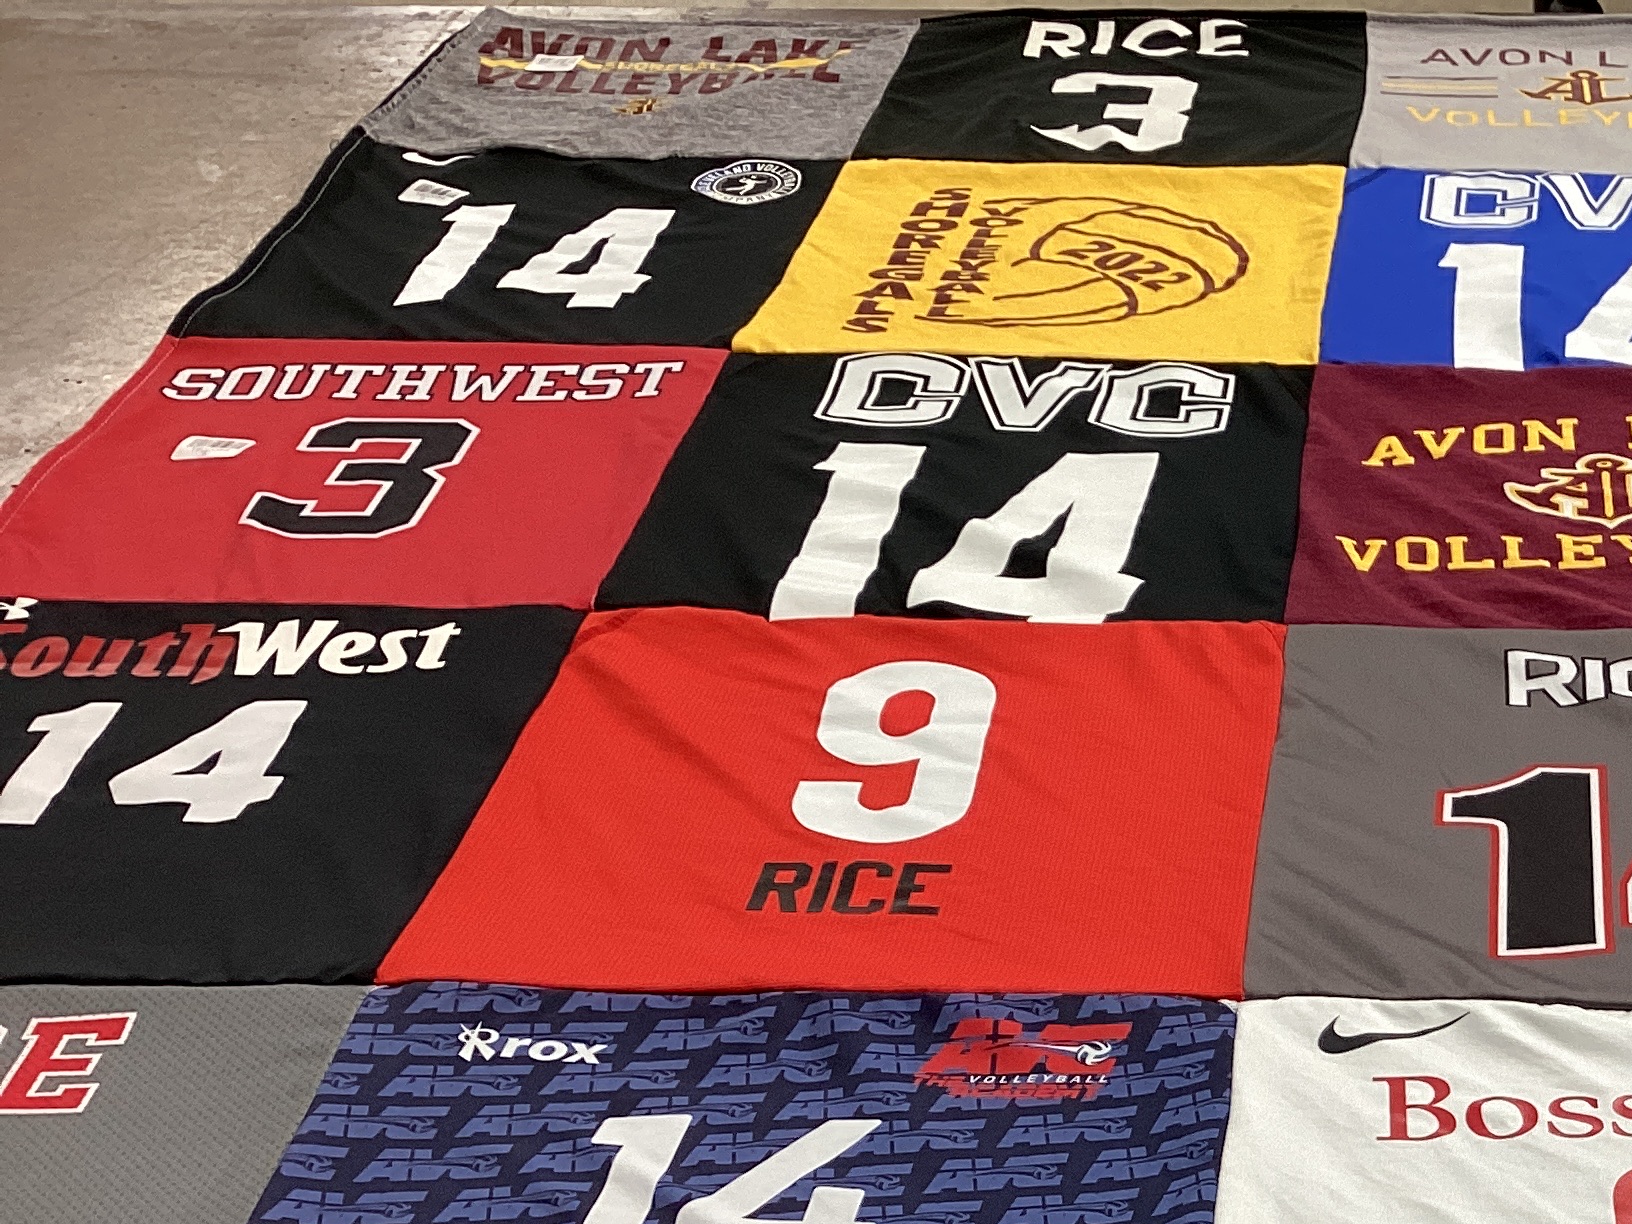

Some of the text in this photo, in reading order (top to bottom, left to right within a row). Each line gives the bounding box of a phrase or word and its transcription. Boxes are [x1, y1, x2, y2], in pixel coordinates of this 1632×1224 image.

[478, 27, 671, 62] AVON
[1023, 19, 1249, 59] RICE
[1420, 47, 1573, 67] AVON
[1030, 72, 1198, 151] 3
[394, 204, 676, 308] 14
[841, 187, 972, 333] SHOREGALS
[1056, 240, 1191, 292] 2022
[162, 360, 687, 402] SOUTHWEST
[814, 351, 1236, 438] CVC
[1360, 417, 1579, 467] AVON
[238, 417, 481, 539] 3
[769, 441, 1160, 624] 14
[0, 700, 308, 825] 14
[791, 660, 997, 844] 9
[744, 860, 953, 916] RICE
[969, 1074, 1109, 1084] VOLLEYBALL
